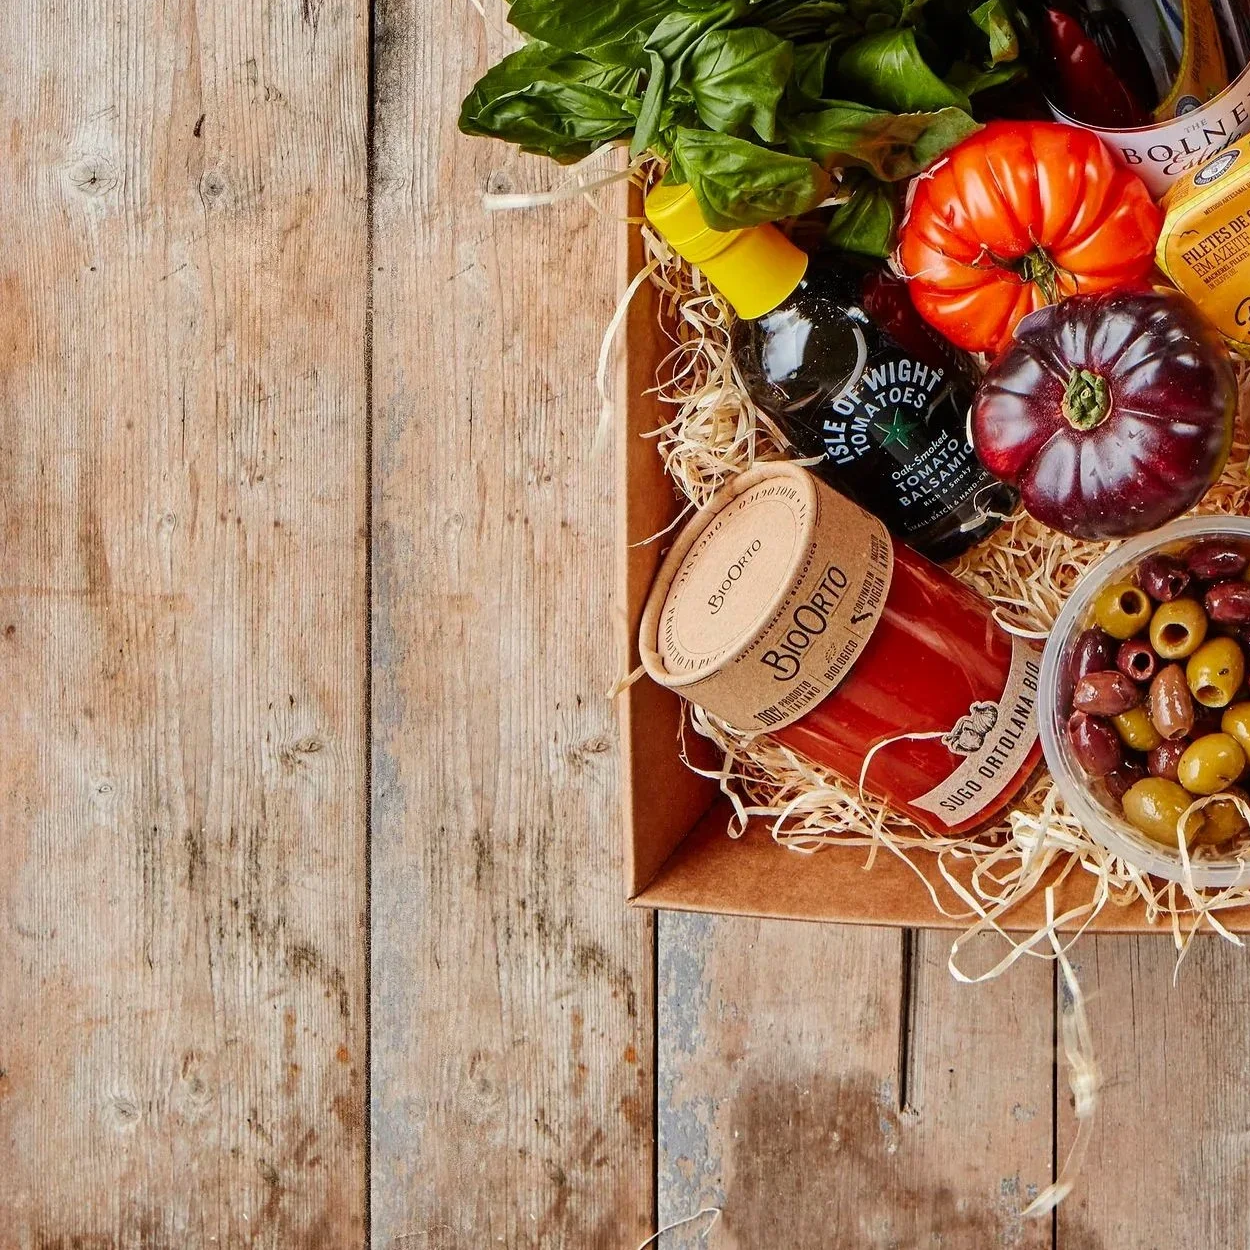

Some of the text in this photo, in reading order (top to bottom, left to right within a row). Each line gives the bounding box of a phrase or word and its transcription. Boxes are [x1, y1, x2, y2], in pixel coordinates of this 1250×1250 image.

[1184, 119, 1207, 133] THE
[1182, 228, 1232, 266] FILETES
[1230, 216, 1249, 234] DE
[1192, 258, 1214, 278] EM
[1204, 252, 1250, 284] MACKEREL FILLETS
[832, 386, 862, 416] OF
[851, 387, 926, 456] TOMATOES
[823, 420, 855, 464] ISLE
[892, 430, 948, 480] Oak-Smoked
[896, 438, 958, 492] TOMATO
[899, 442, 974, 506] BALSAMIC
[739, 486, 798, 510] BIOLOGICO
[924, 494, 940, 507] Rich
[949, 466, 970, 488] Smoky
[907, 504, 953, 531] SMALL-BATCH
[678, 522, 722, 587] ORGANIC
[734, 542, 818, 664] NATURALMENTE BIOLOGICO
[854, 570, 875, 614] COLTIVATO IN
[868, 577, 885, 609] PUGLIA
[667, 608, 695, 670] PRODOTTO IN
[824, 640, 858, 682] BIOLOGICO
[779, 680, 812, 708] PRODOTTO
[787, 686, 820, 714] ITALIANO
[753, 706, 789, 726] 100%
[940, 660, 1040, 811] SUGO ORTOLANA BIO
